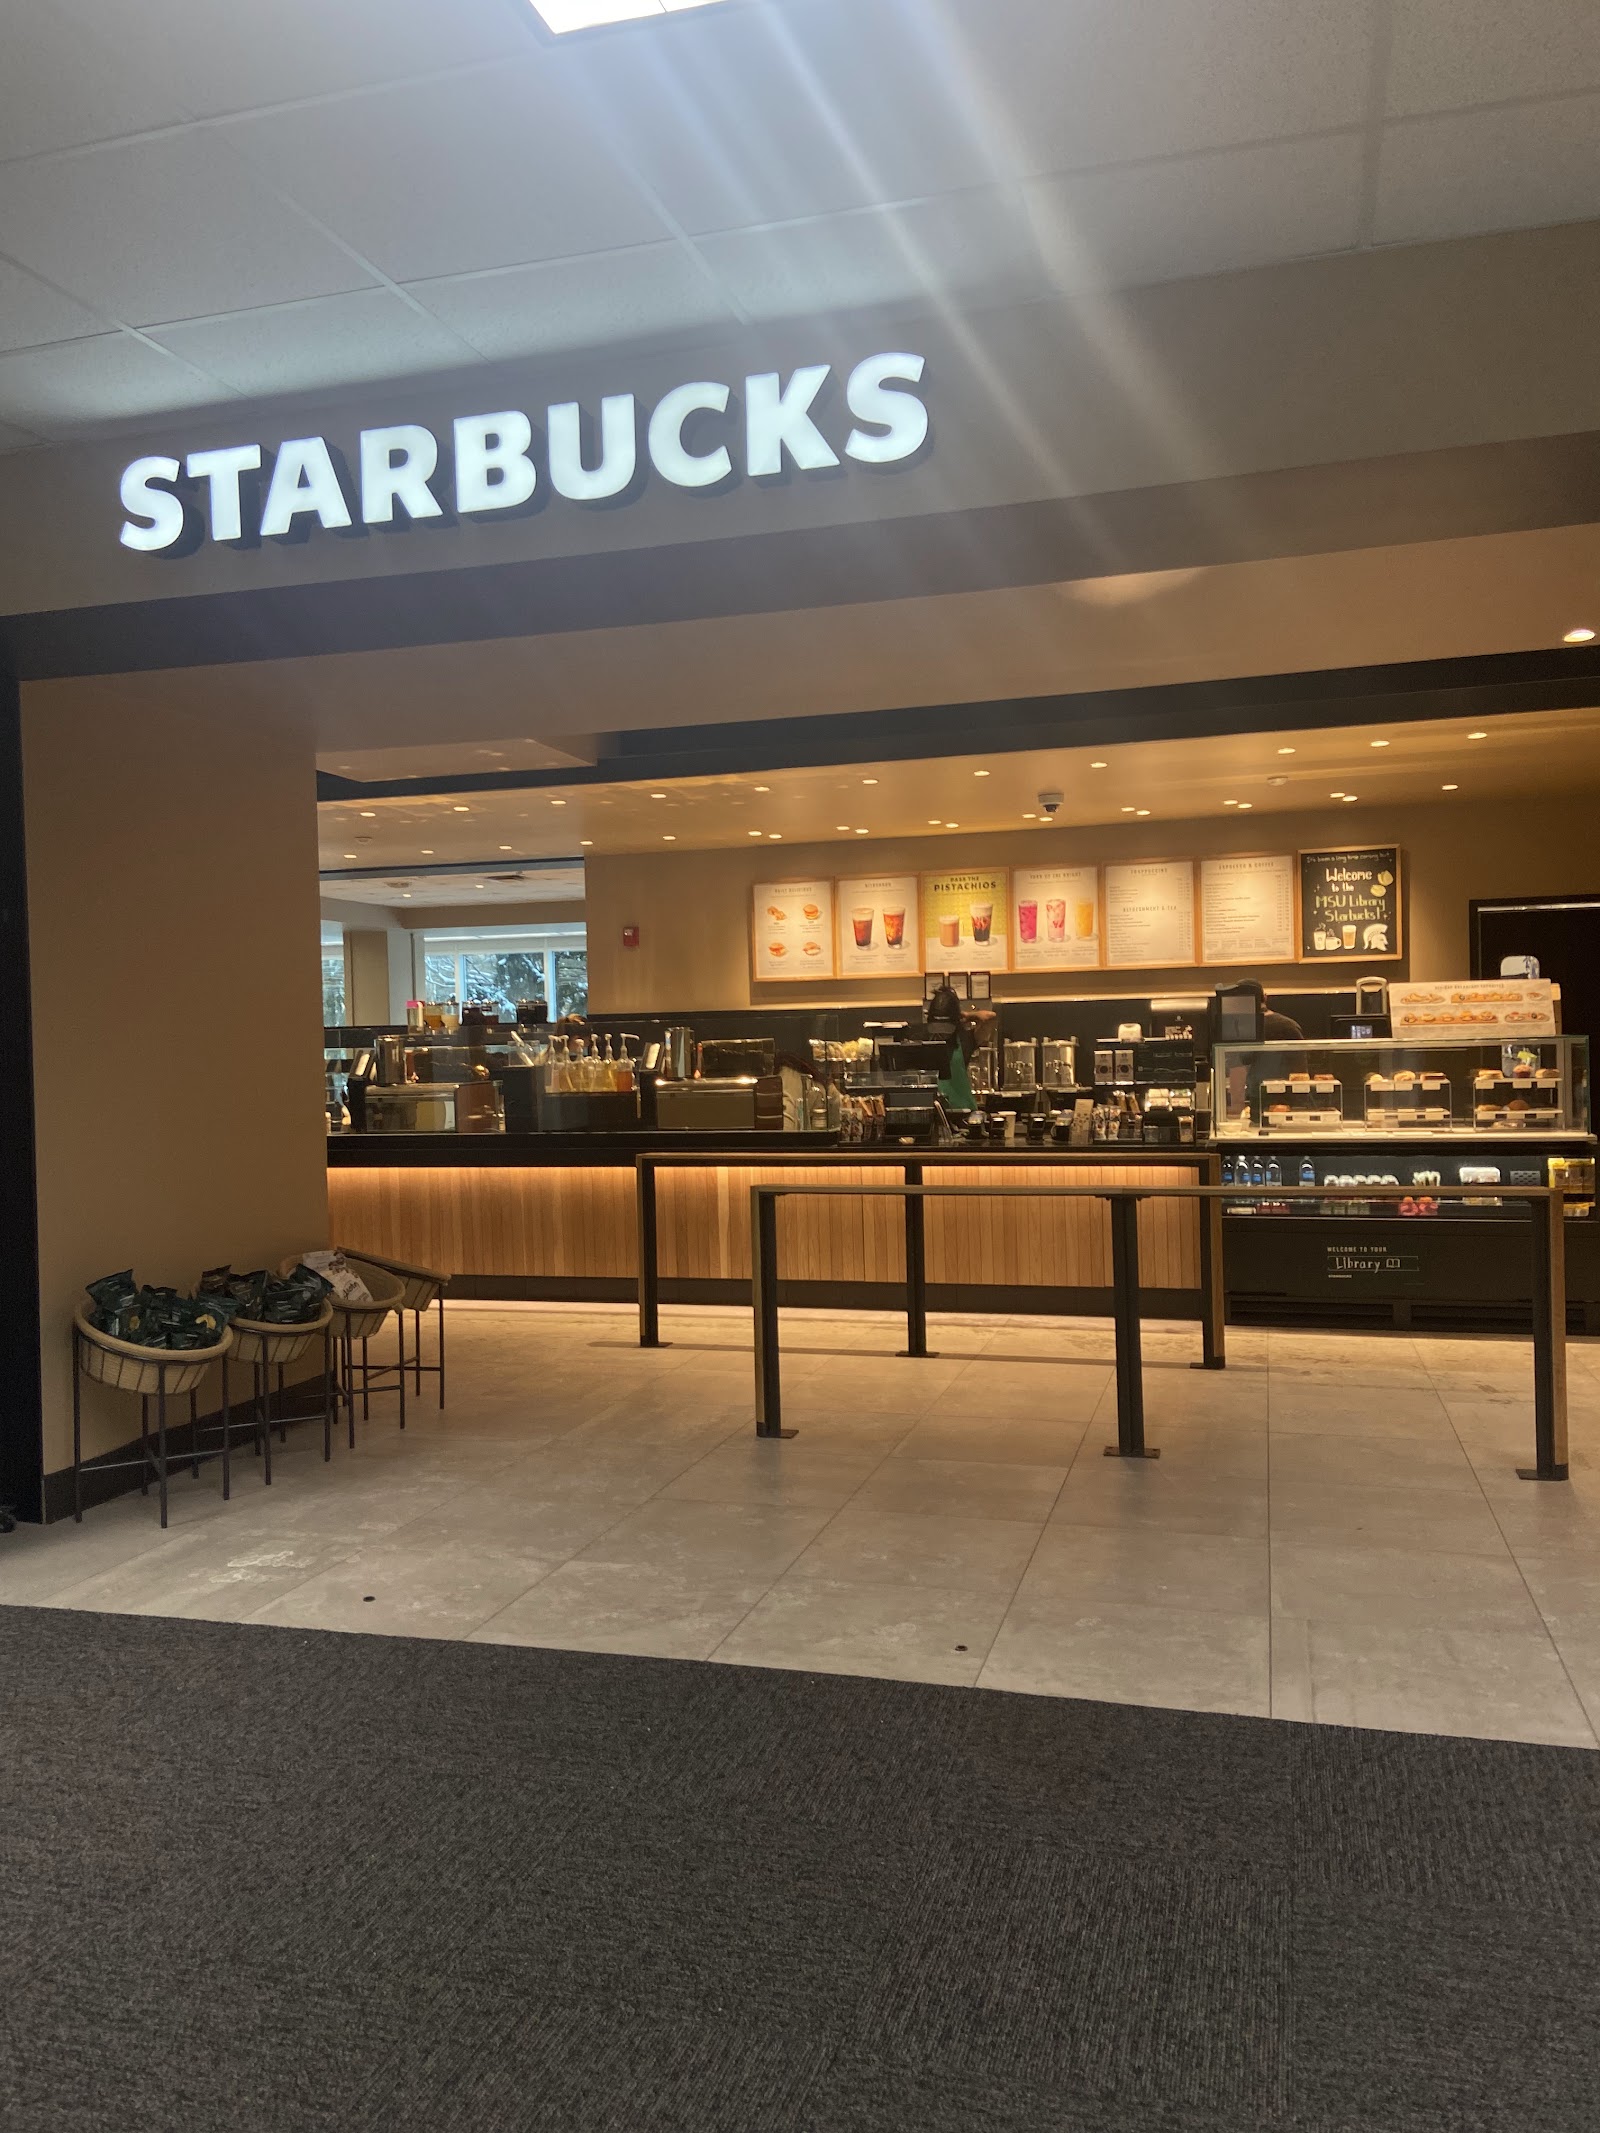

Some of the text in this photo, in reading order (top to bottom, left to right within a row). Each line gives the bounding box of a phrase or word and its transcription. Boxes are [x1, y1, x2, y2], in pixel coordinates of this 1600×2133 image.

[120, 351, 929, 552] STARBUCKS
[1325, 867, 1373, 882] Welcome
[933, 880, 997, 892] PISTACHIOS
[1331, 881, 1355, 893] to the
[1315, 894, 1386, 912] MSU Library
[1324, 907, 1381, 923] Starbucks!
[1335, 1256, 1381, 1274] Library
